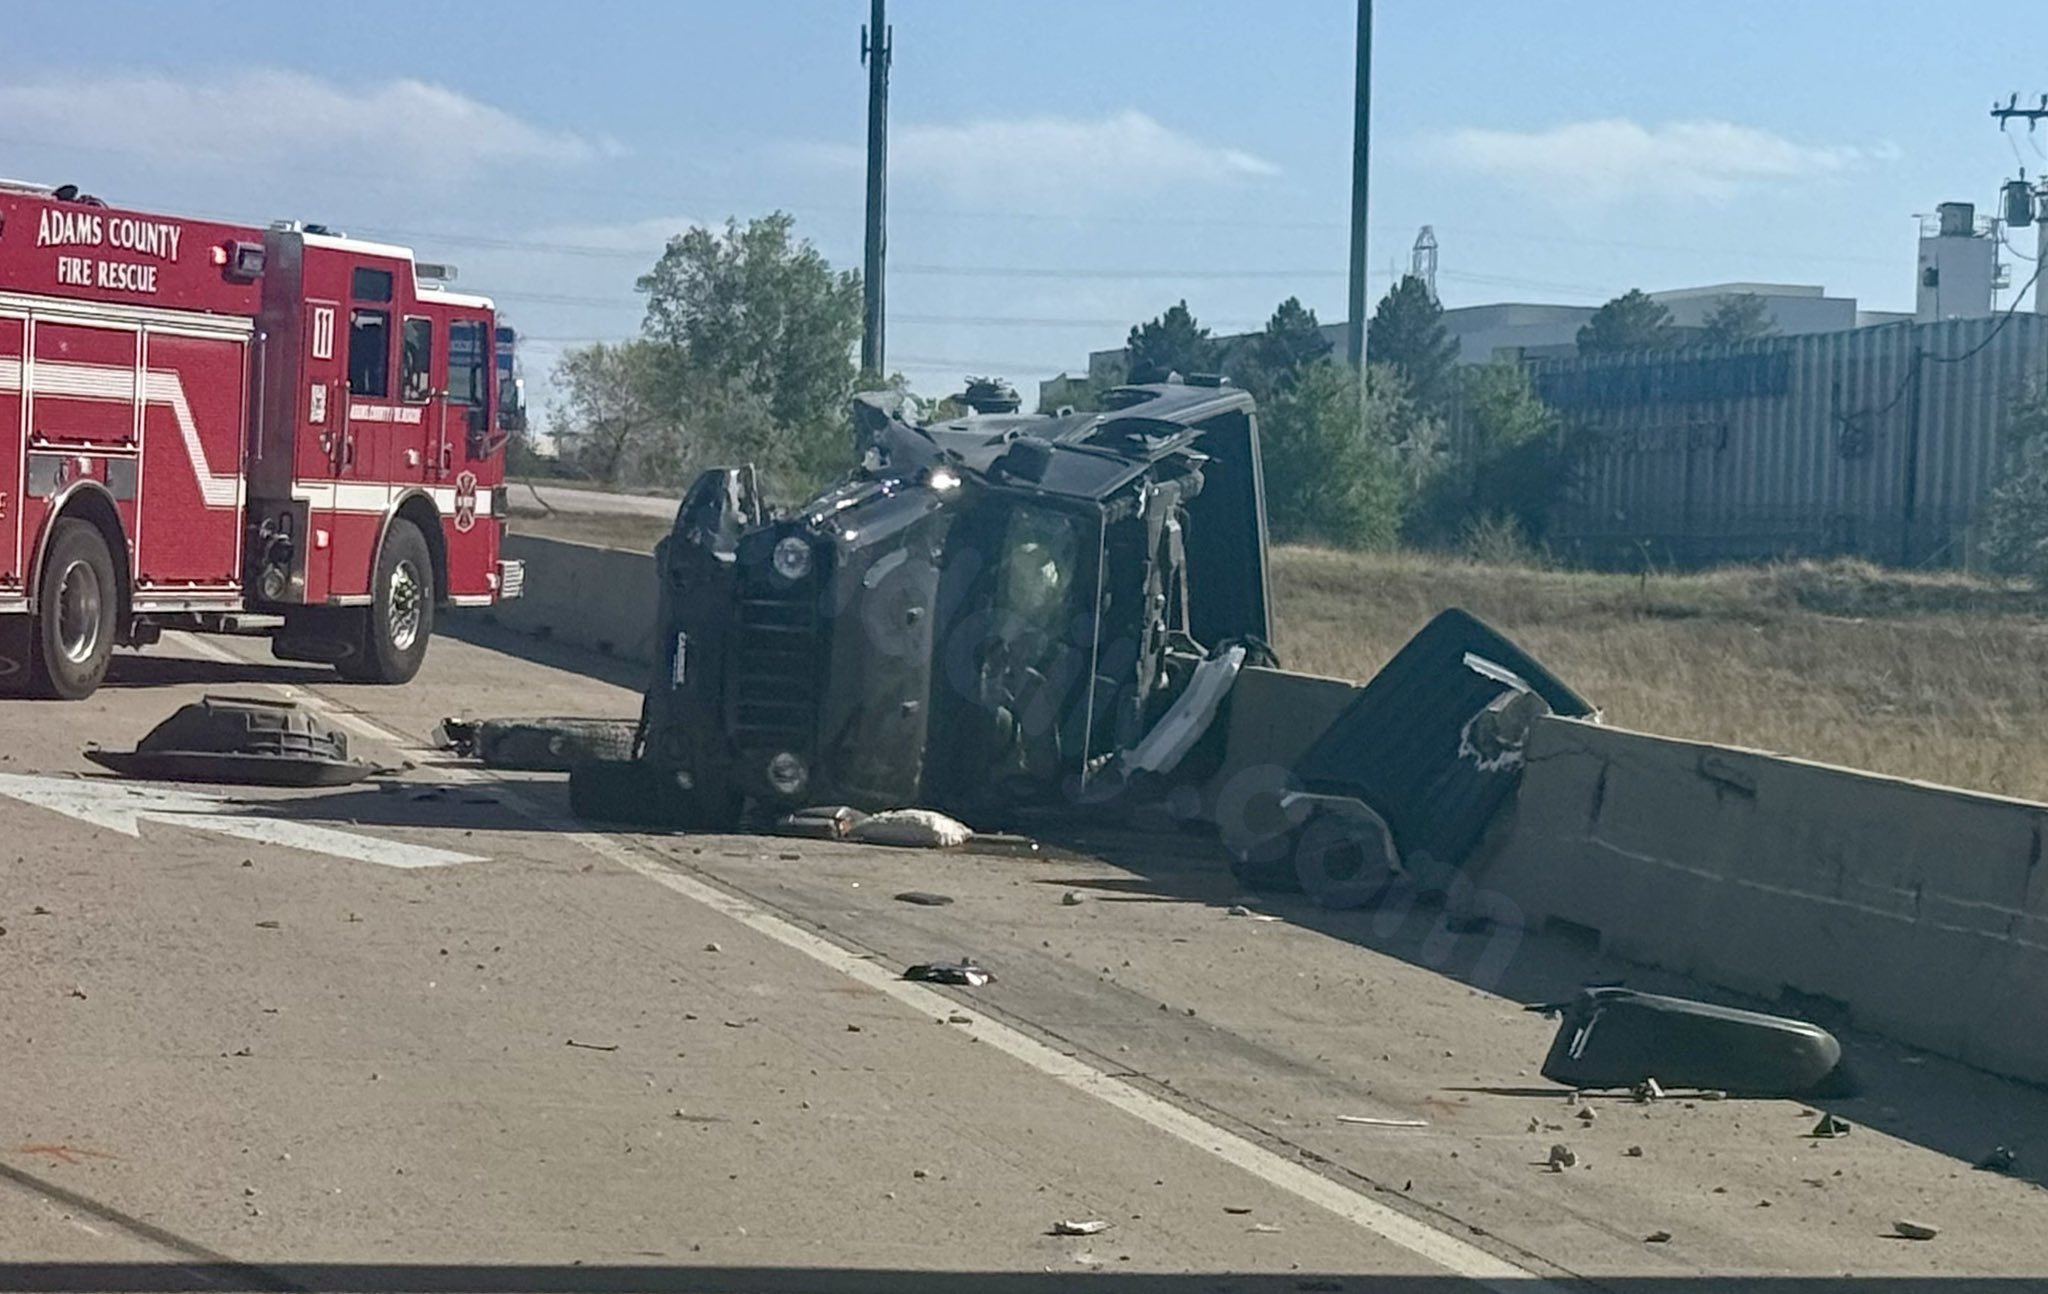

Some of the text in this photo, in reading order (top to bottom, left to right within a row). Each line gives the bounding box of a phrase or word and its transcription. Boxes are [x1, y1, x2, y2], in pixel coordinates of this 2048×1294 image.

[36, 207, 181, 262] ADAMS COUNTY
[58, 256, 157, 293] FIRE RESCUE
